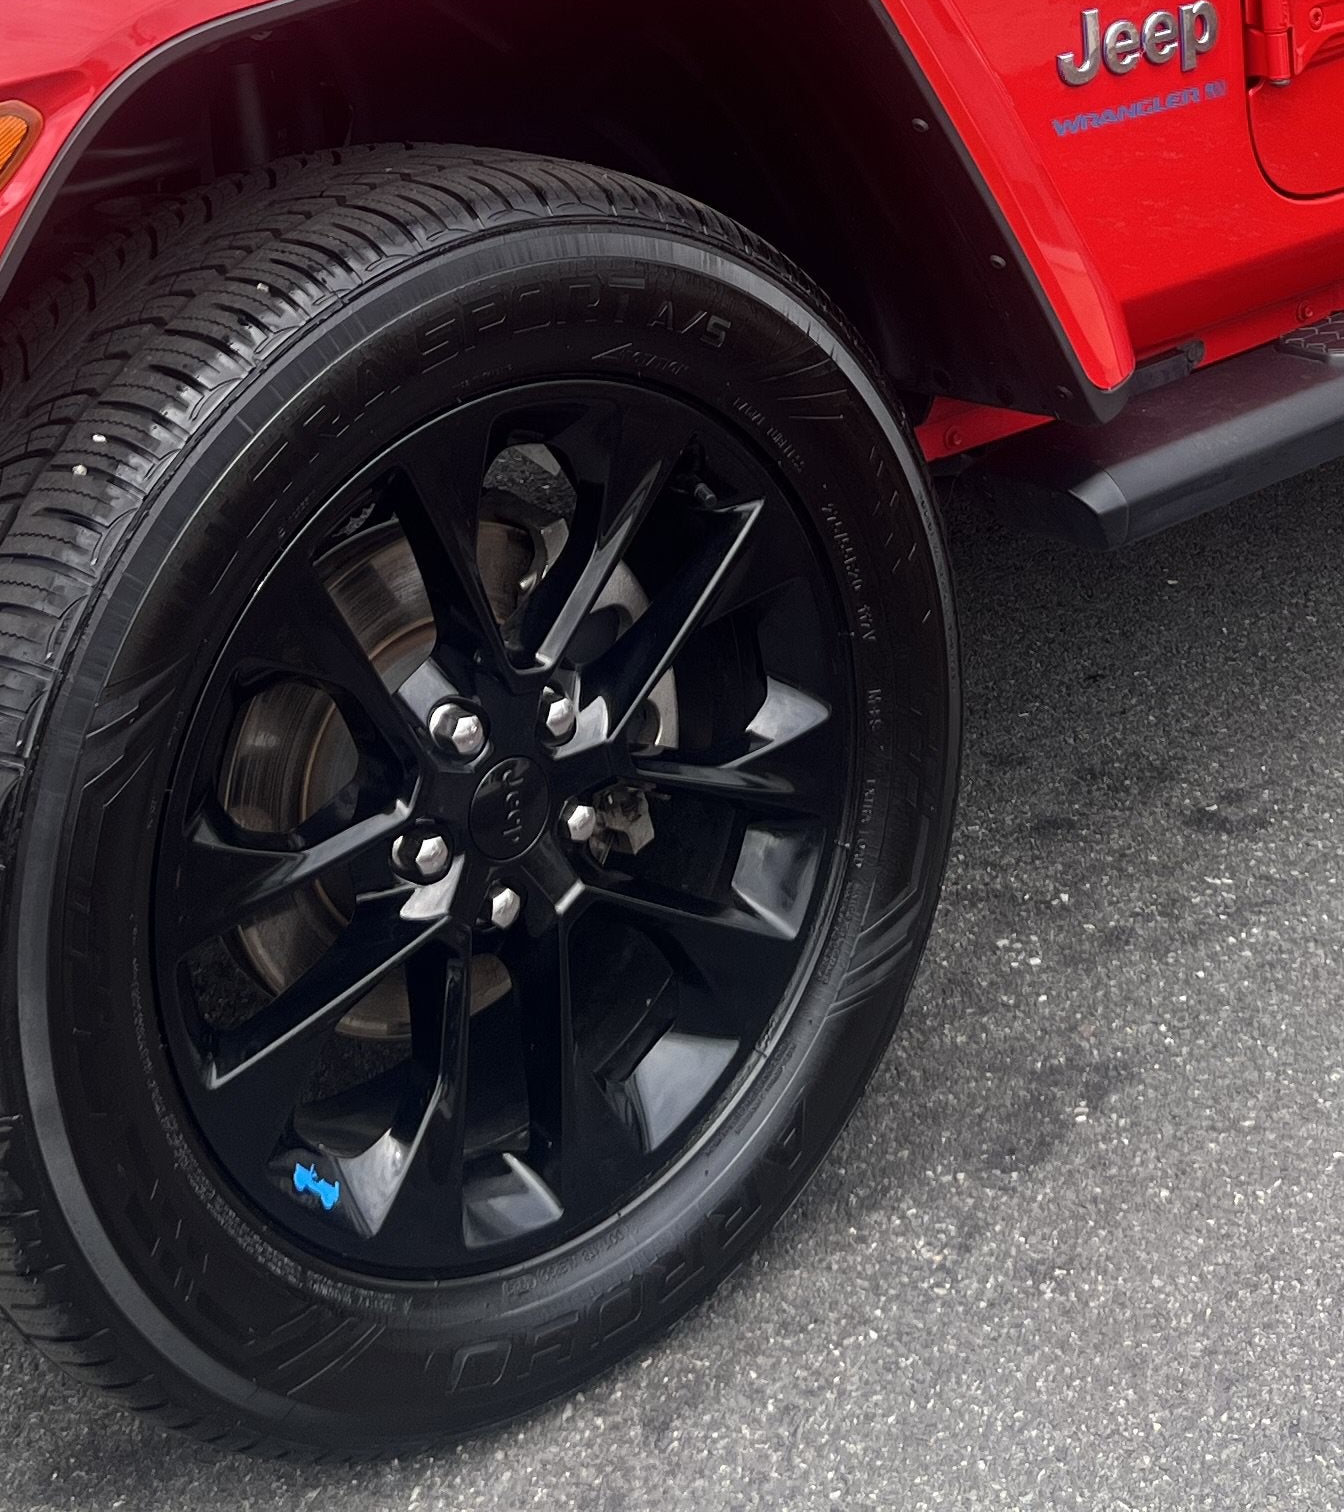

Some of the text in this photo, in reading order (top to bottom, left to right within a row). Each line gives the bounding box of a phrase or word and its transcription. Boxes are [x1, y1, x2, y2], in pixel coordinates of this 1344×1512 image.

[1057, 0, 1218, 87] Jeep
[1053, 88, 1200, 136] WRANGLER
[502, 769, 524, 842] Jeep
